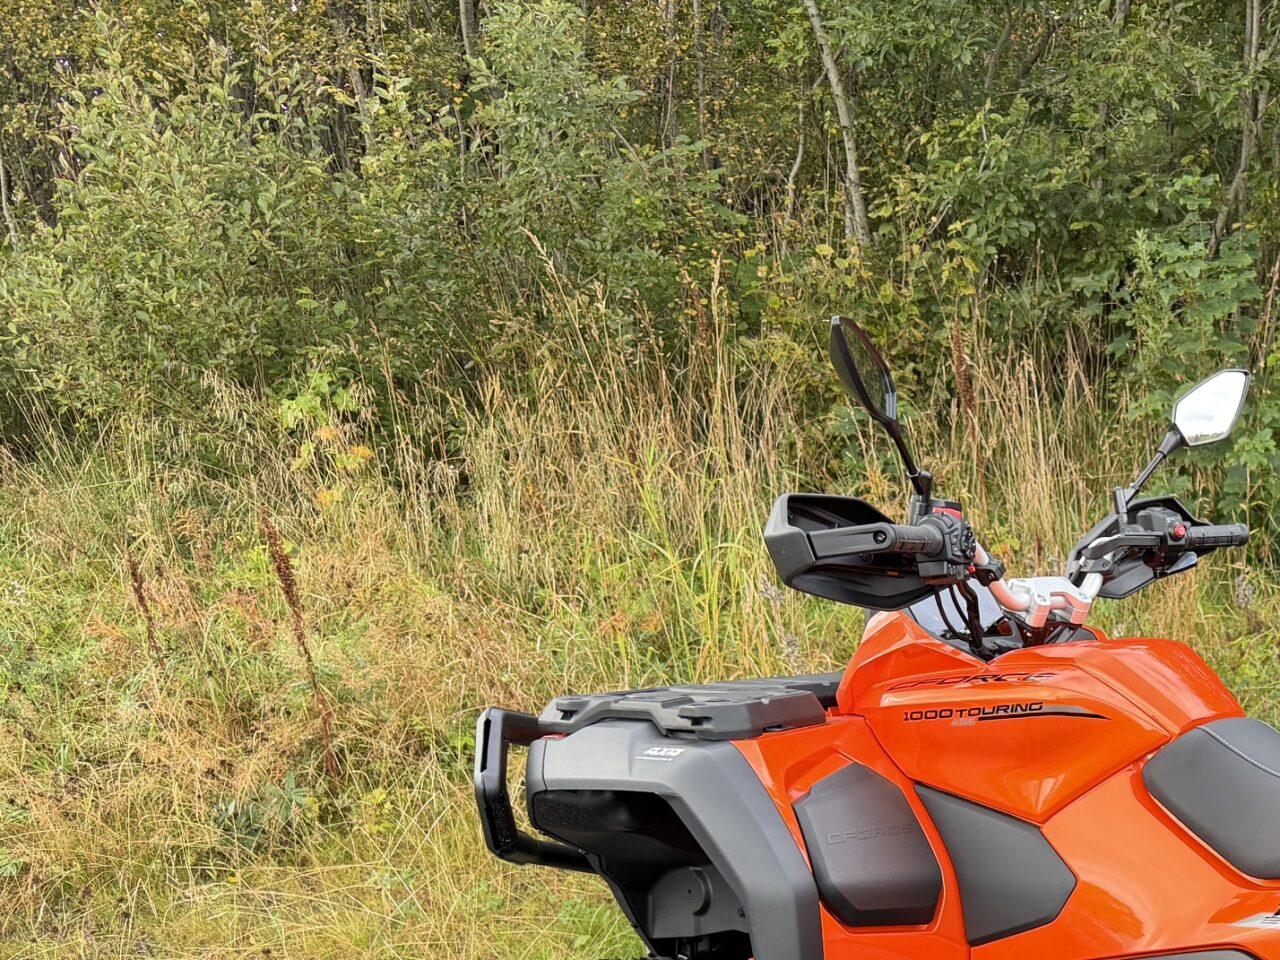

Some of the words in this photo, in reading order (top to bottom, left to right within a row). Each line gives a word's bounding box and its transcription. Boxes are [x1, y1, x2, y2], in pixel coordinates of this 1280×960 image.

[903, 708, 953, 721] 1000
[954, 702, 1044, 718] TOURING
[826, 823, 914, 846] CFORCE
